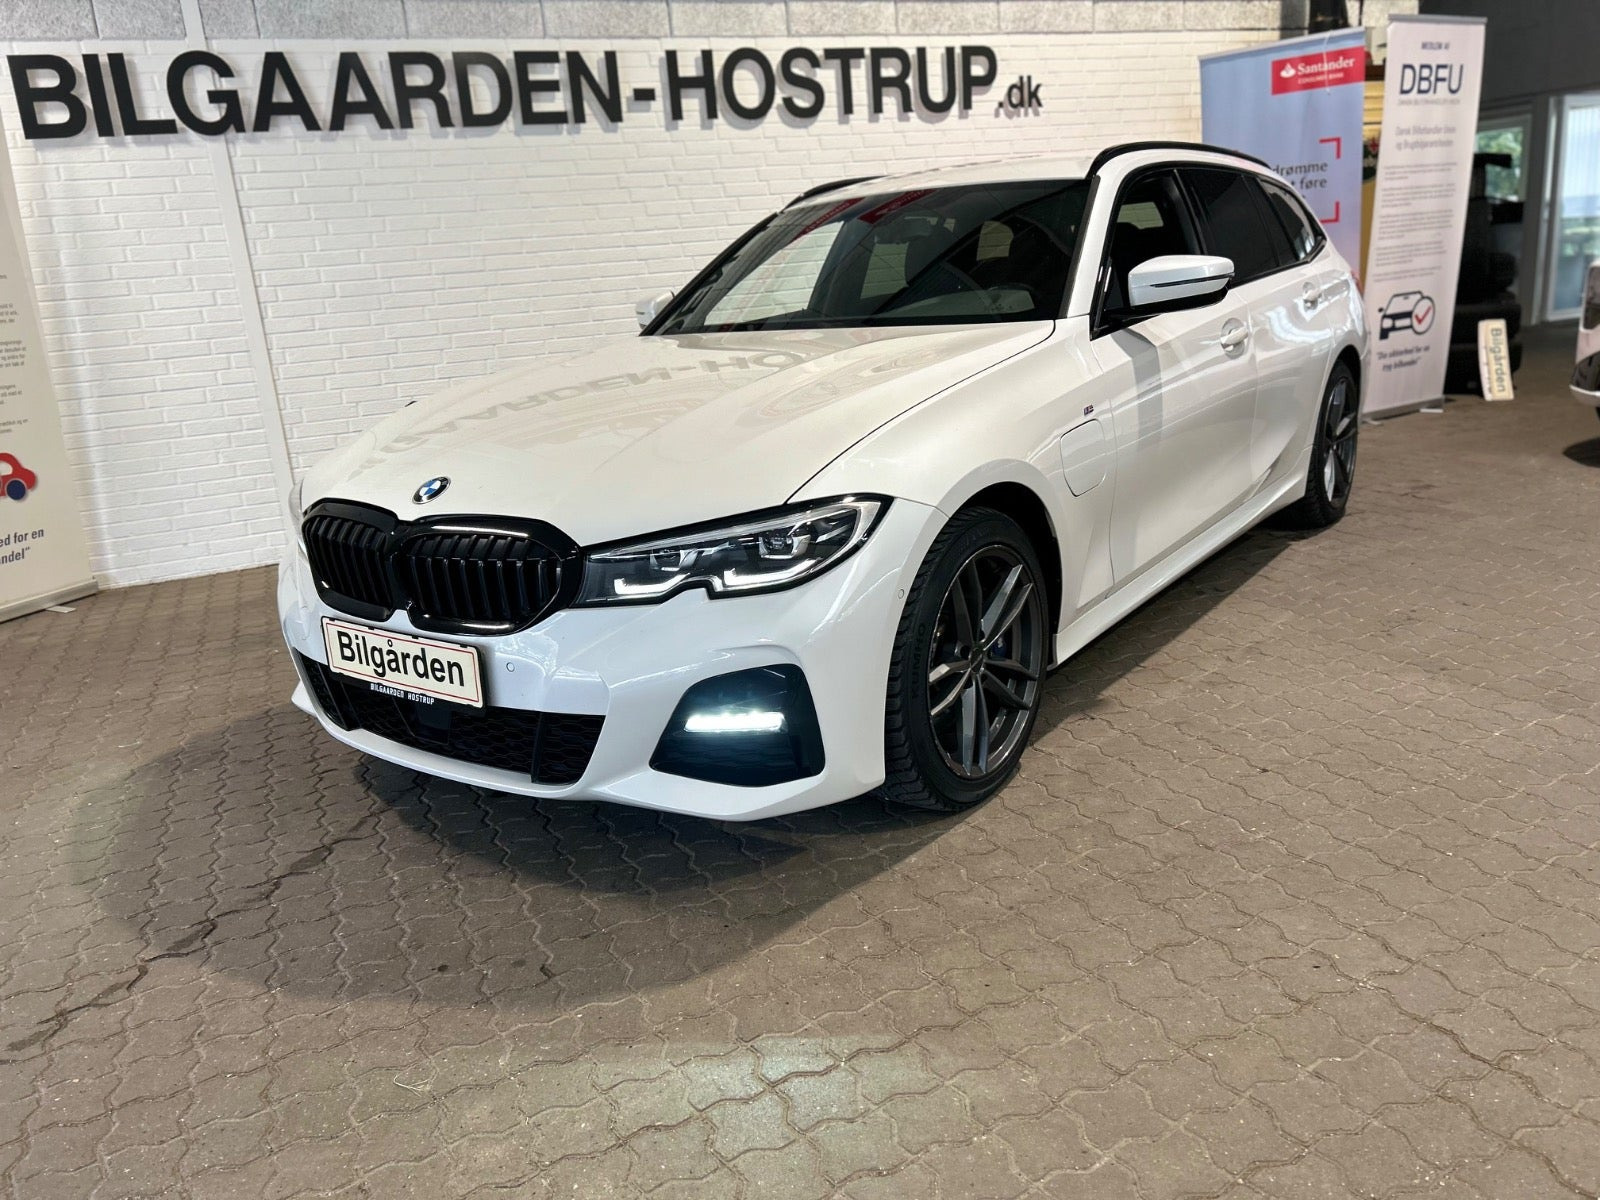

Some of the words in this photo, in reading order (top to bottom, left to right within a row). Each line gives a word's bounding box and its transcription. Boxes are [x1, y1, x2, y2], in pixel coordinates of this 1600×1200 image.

[1297, 55, 1356, 76] Santander
[1399, 63, 1464, 95] DBFU
[1300, 177, 1328, 190] føre
[1489, 328, 1507, 392] Bilgården
[13, 531, 29, 544] for
[31, 529, 44, 540] en
[336, 630, 465, 687] Bilgården
[370, 682, 405, 698] BILGAARDEN
[407, 692, 435, 705] HOSTRUP
